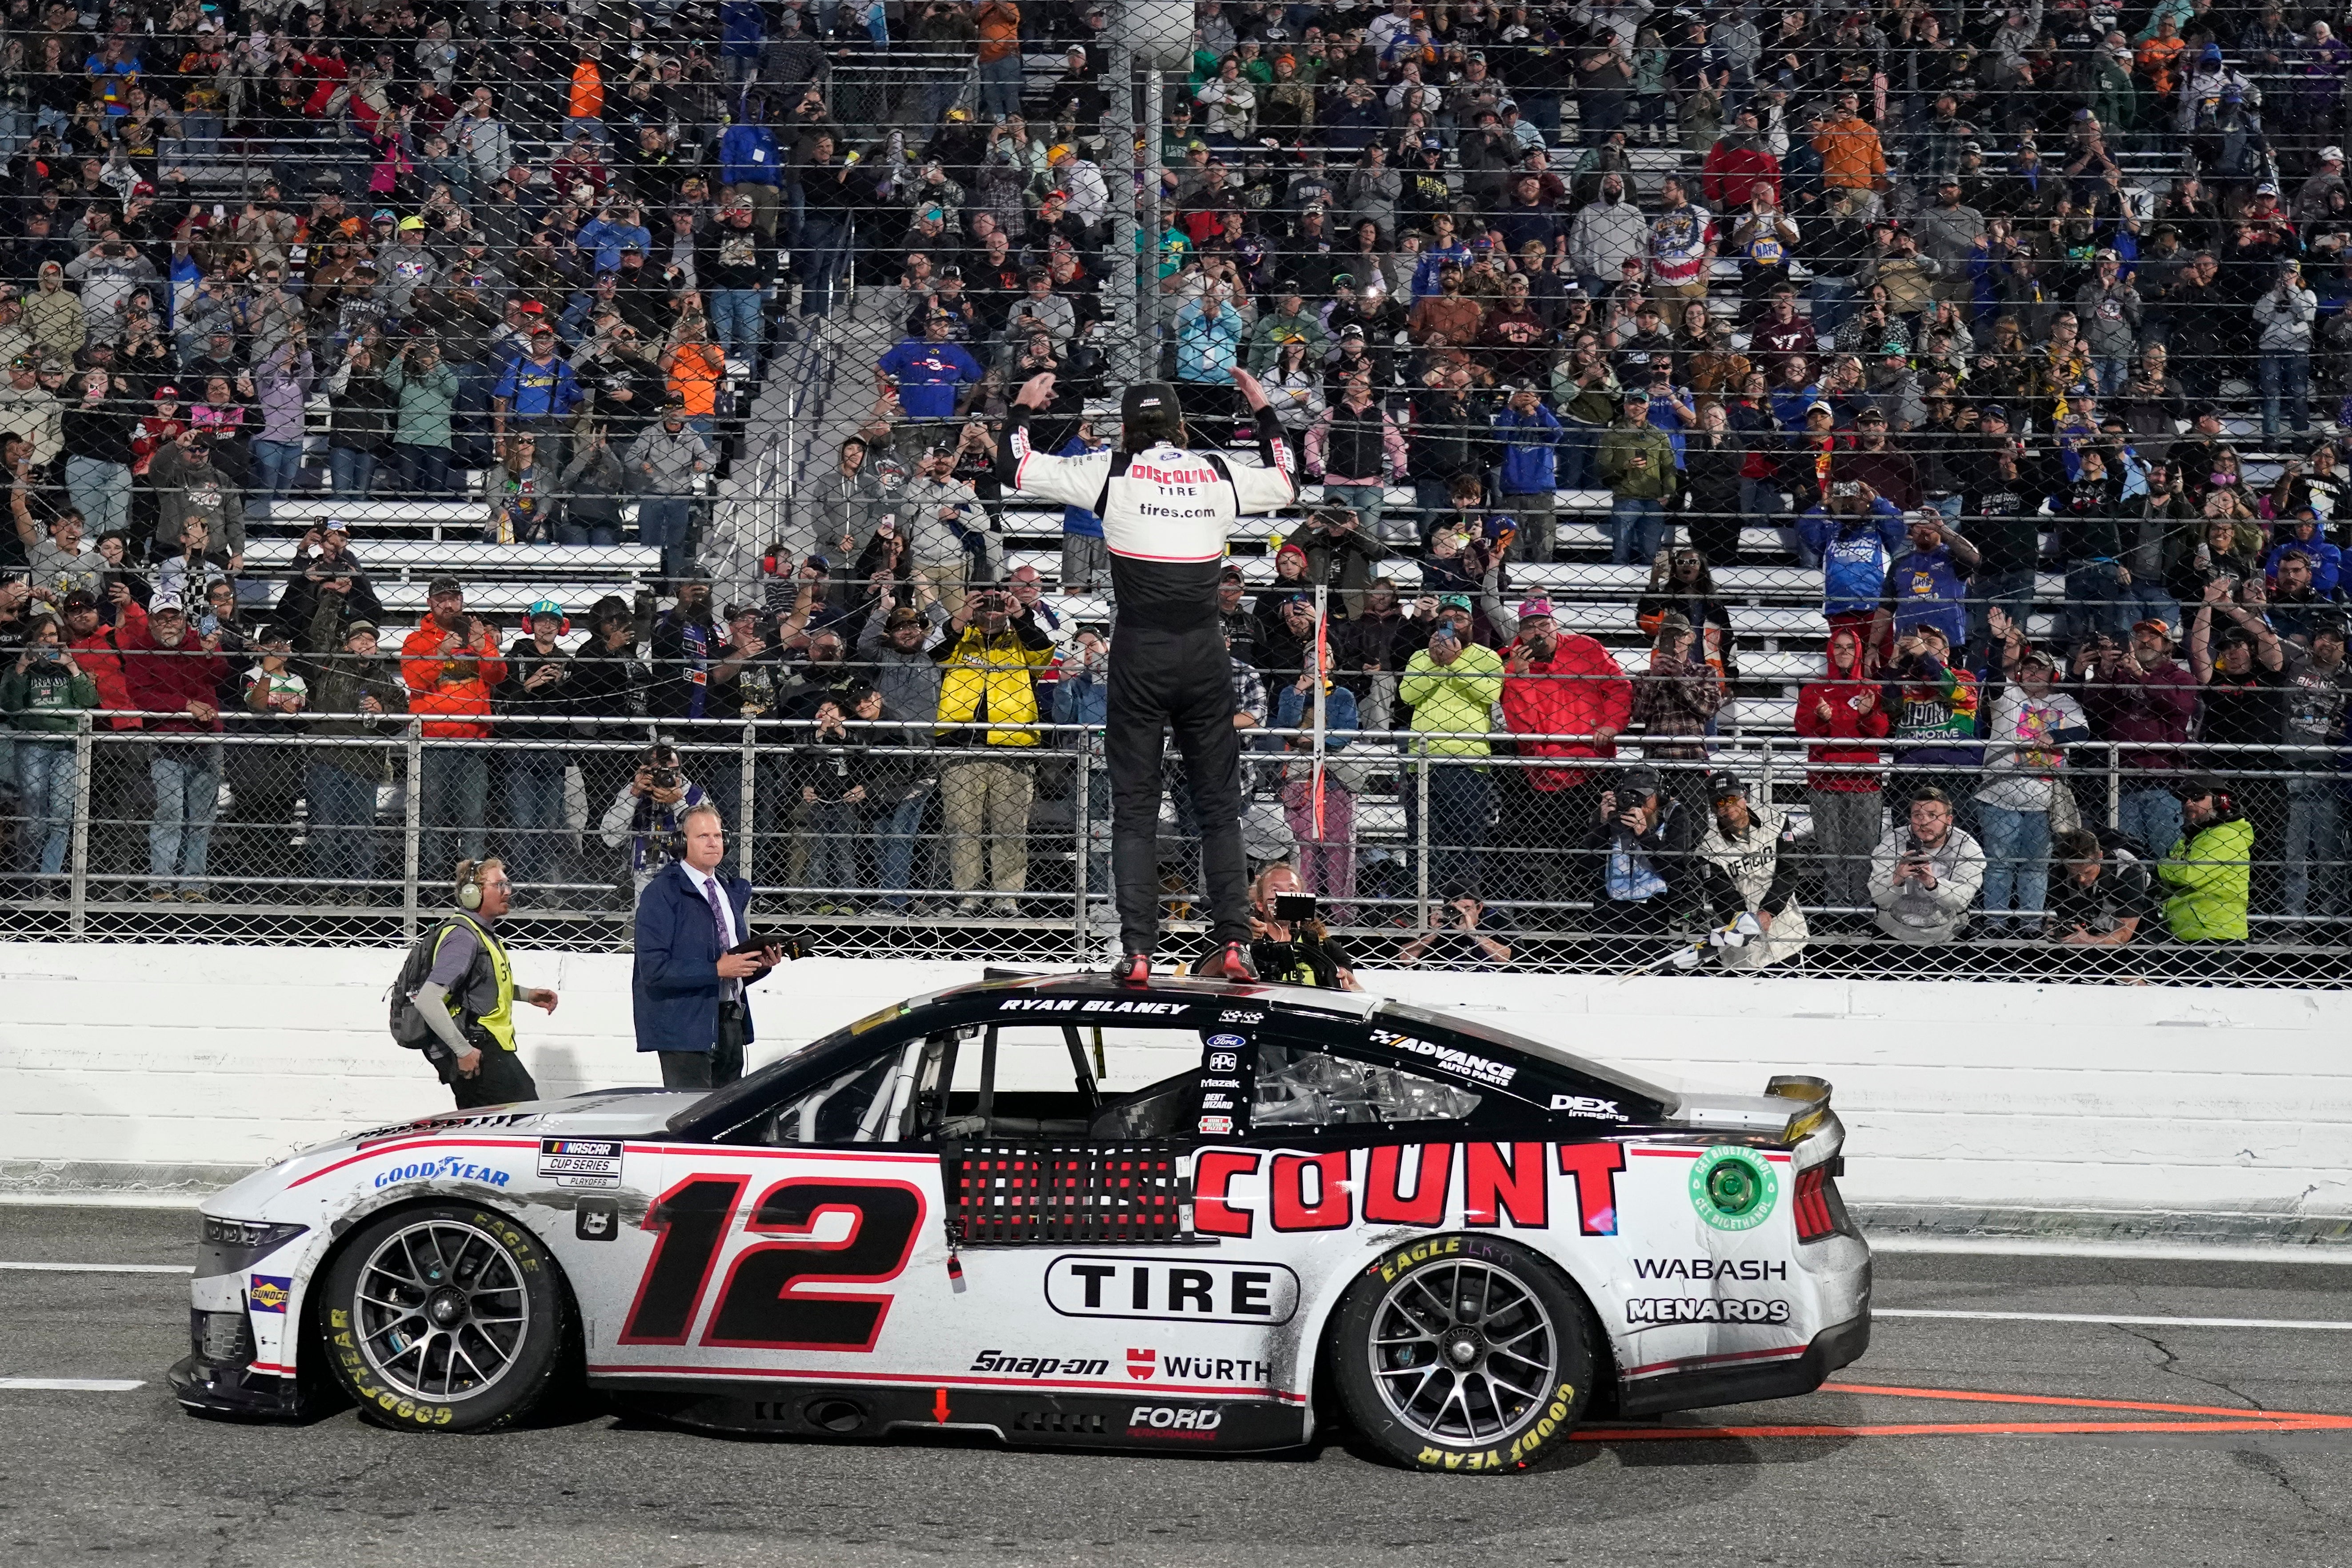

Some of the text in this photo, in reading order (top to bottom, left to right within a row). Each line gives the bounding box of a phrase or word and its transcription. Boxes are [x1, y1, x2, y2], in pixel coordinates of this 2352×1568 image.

[1756, 243, 1778, 257] NAPA
[1132, 464, 1218, 484] DISCOUNT
[1158, 486, 1198, 497] TIRE
[1140, 503, 1216, 518] tires.com
[540, 601, 554, 612] 11
[999, 1000, 1191, 1015] RYAN BLANEY
[1213, 1035, 1238, 1045] Ford
[1212, 1054, 1235, 1069] PPG
[1396, 1038, 1517, 1079] ADVANCE
[1438, 1060, 1511, 1087] AUTO PARTS
[1200, 1078, 1240, 1088] Mazak
[1202, 1101, 1234, 1109] WIZARD
[1551, 1094, 1618, 1114] DEX
[1568, 1109, 1628, 1122] imaging
[566, 1142, 612, 1155] NASCAR
[550, 1158, 610, 1171] CUP SERIES
[1695, 1146, 1772, 1179] GET BIOETHANOL
[570, 1177, 608, 1186] PLAYOFFS
[1192, 1141, 1628, 1239] COUNT
[1695, 1197, 1772, 1229] GET BIOETHANOL
[474, 1213, 540, 1272] EAGLE
[616, 1172, 928, 1353] 12
[1380, 1237, 1462, 1283] EAGLE
[1633, 1258, 1786, 1280] WABASH
[252, 1289, 288, 1301] SUNOCO
[1071, 1264, 1272, 1316] TIRE
[1626, 1298, 1789, 1324] MENARDS
[969, 1350, 1272, 1383] Snap-on WÜRTH
[1129, 1406, 1222, 1430] FORD
[1125, 1428, 1217, 1440] PERFORMANCE
